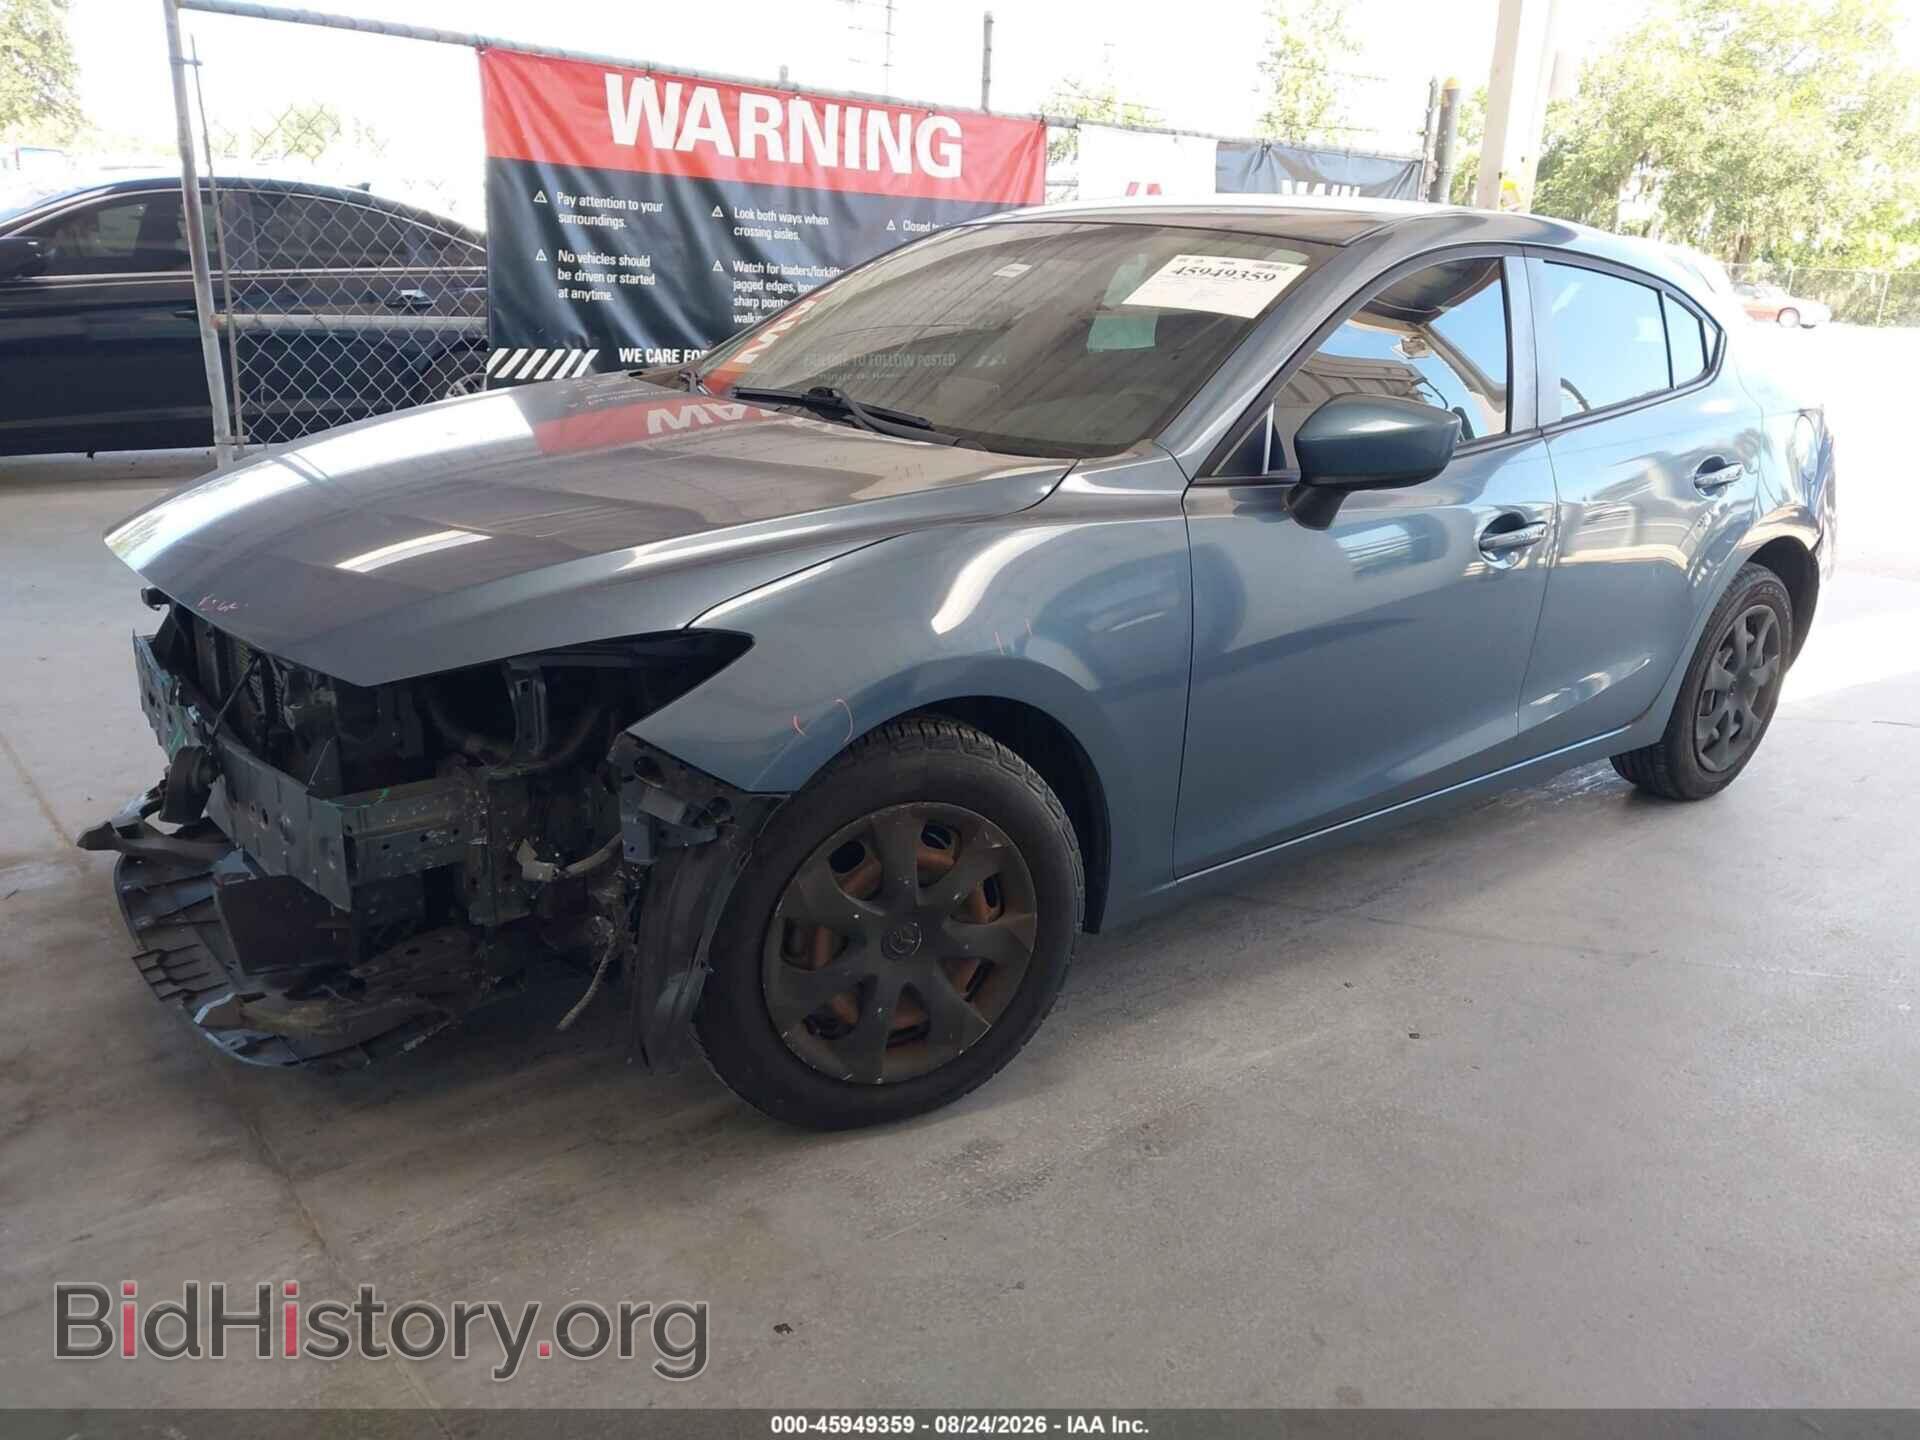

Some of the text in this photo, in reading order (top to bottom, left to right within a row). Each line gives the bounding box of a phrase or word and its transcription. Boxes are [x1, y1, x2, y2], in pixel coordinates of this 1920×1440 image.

[604, 73, 963, 178] WARNING
[556, 191, 664, 214] Pay attention to your
[558, 213, 627, 230] surroundings.
[734, 207, 829, 225] Look both ways when
[734, 226, 801, 240] crossing aisles.
[903, 219, 931, 232] Closed
[558, 250, 651, 267] No vehicles should
[732, 260, 764, 273] Watch
[766, 263, 779, 274] for
[558, 269, 656, 286] be driven or started
[733, 278, 764, 293] jagged
[766, 281, 797, 294] edges,
[558, 287, 614, 302] at anytime.
[734, 296, 759, 310] sharp
[618, 347, 643, 363] WE
[645, 348, 680, 363] CARE
